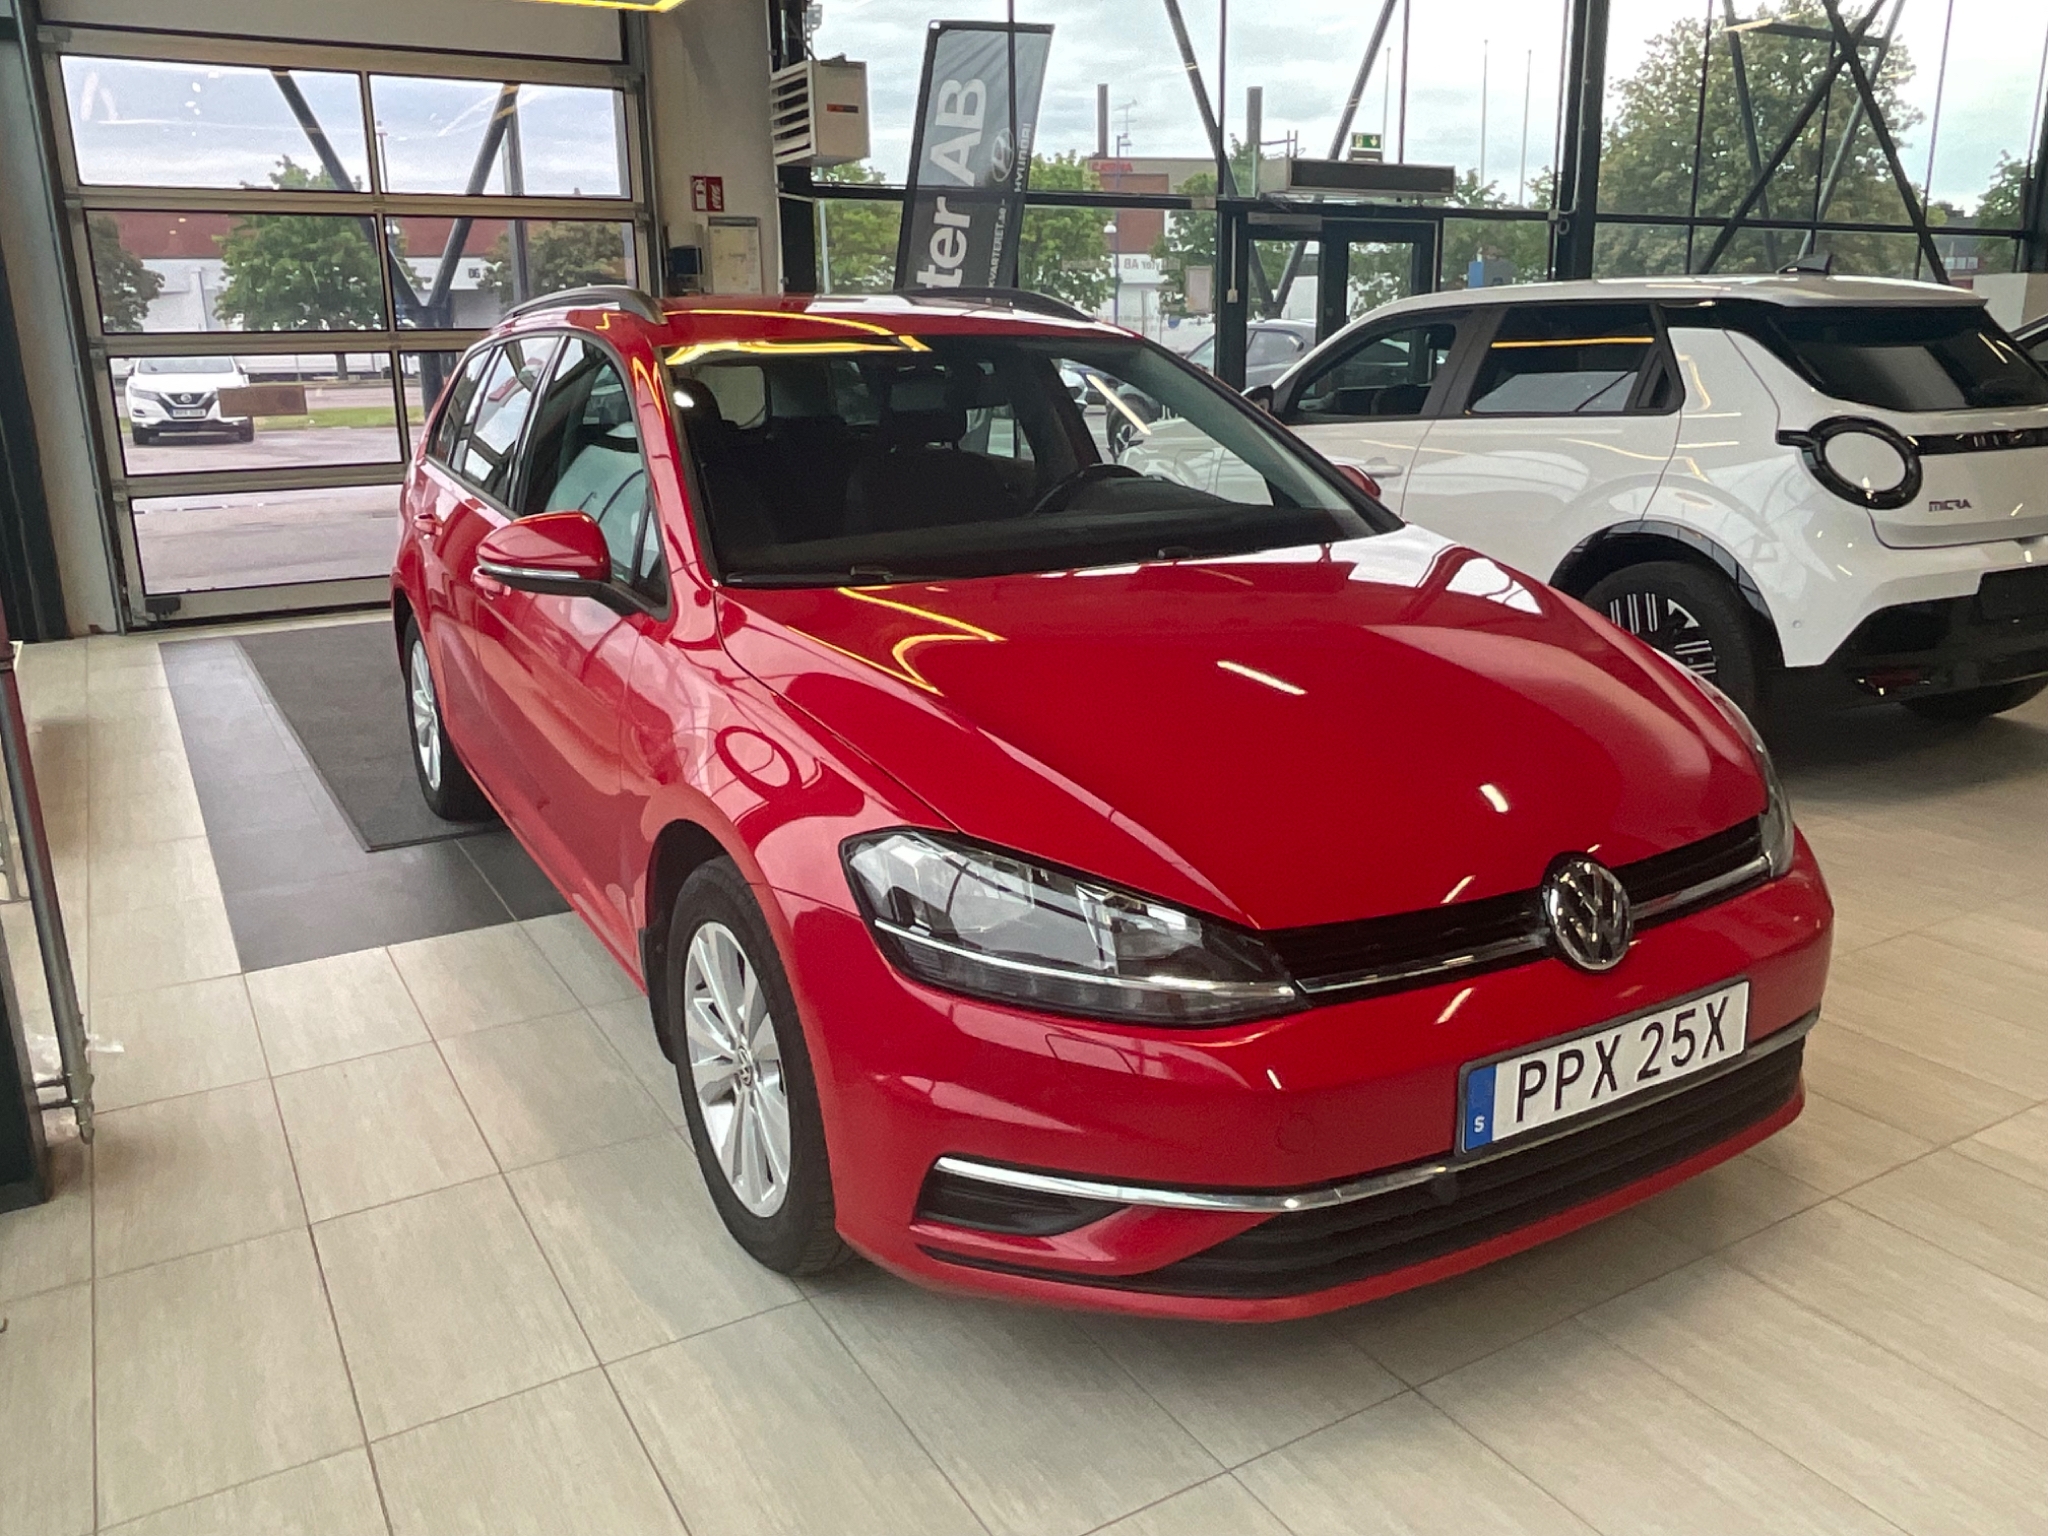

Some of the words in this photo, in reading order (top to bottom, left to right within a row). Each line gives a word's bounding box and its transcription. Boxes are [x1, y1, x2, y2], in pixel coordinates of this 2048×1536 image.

[930, 78, 987, 187] AB
[1928, 499, 1972, 512] MICRA
[1473, 1115, 1485, 1134] S
[1515, 1034, 1622, 1123] PPX
[1636, 996, 1729, 1083] 25X
